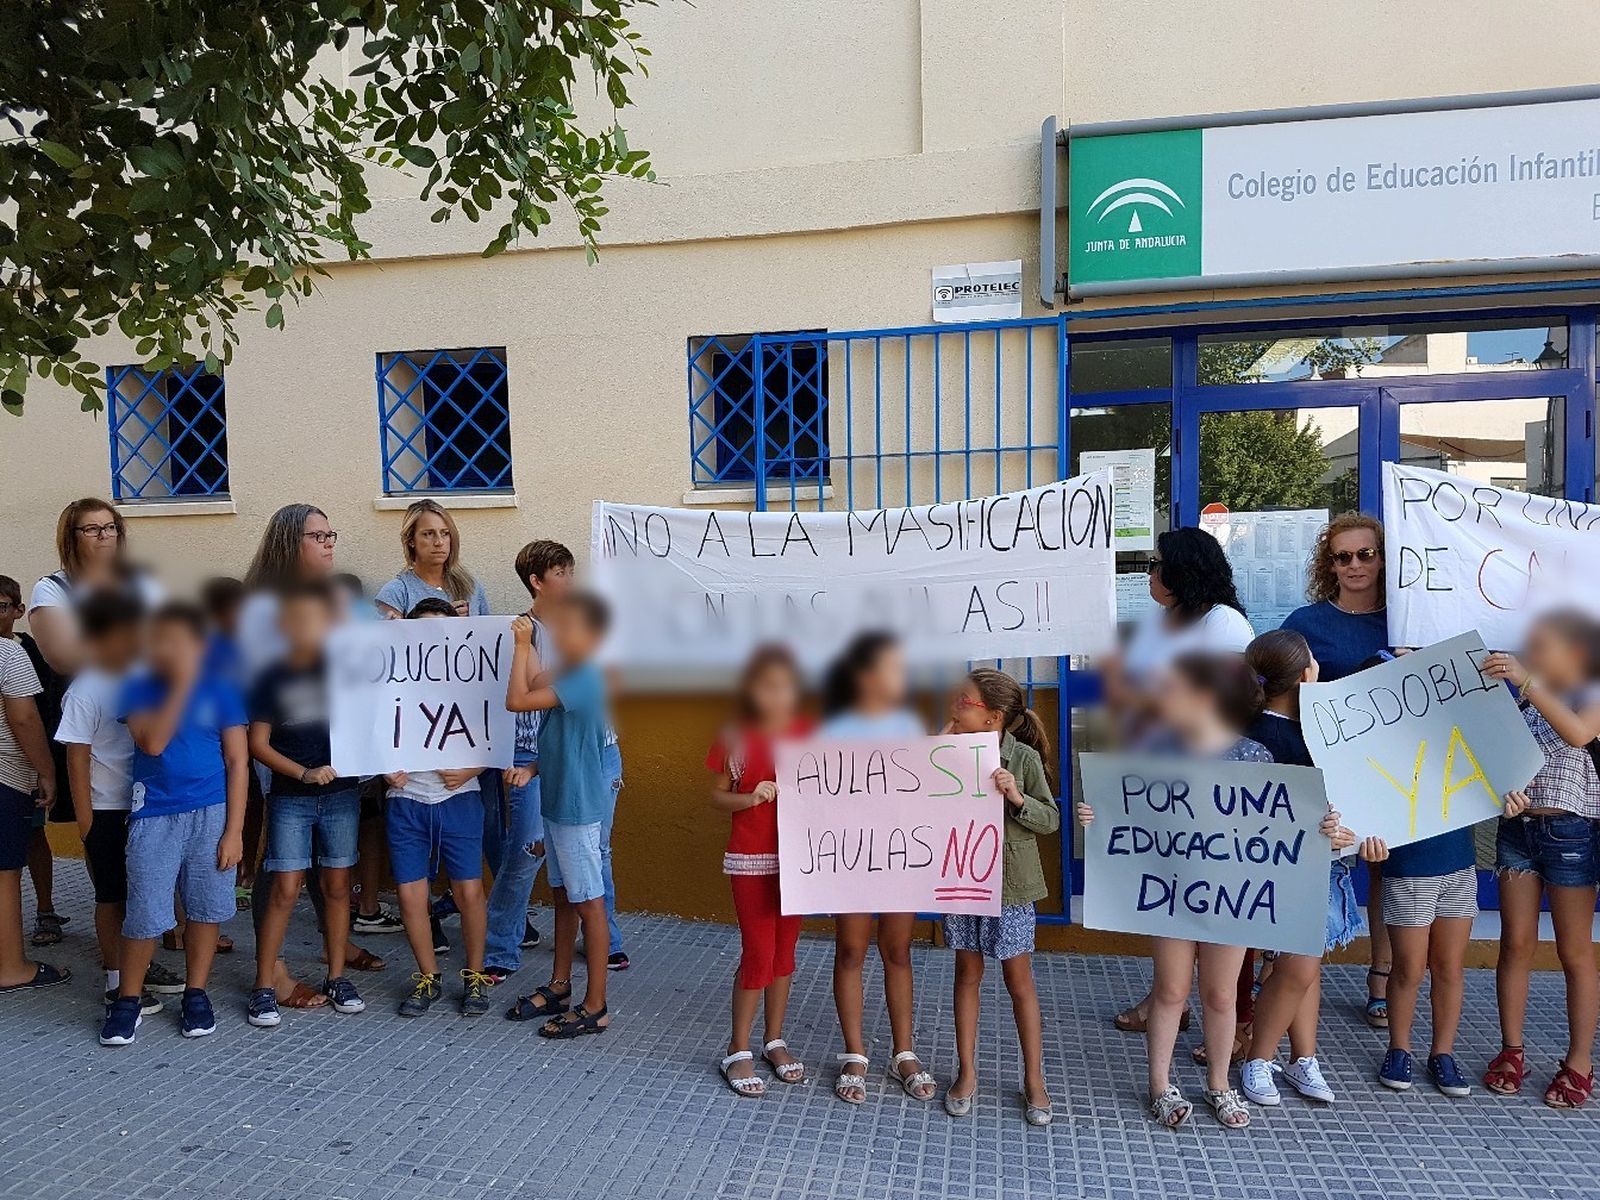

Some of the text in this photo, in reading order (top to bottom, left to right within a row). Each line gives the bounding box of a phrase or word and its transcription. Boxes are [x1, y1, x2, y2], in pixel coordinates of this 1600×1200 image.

[1228, 169, 1317, 202] Colegio
[1327, 166, 1356, 193] de
[1367, 156, 1497, 190] Educación
[1085, 235, 1187, 253] JUNTA DE ANDALUCIA
[697, 511, 730, 558] A
[748, 511, 818, 557] LA
[847, 476, 1112, 556] MASIFICACIÓN
[1399, 477, 1502, 529] POR
[1398, 546, 1452, 591] DE
[1312, 648, 1499, 750] DESDOBLE
[796, 744, 988, 798] AULAS SI
[1366, 724, 1504, 839] YA
[1121, 774, 1296, 823] POR UNA
[799, 819, 999, 883] JAULAS NO
[1107, 825, 1306, 866] EDUCACIÓN
[1136, 873, 1277, 925] DIGNA
